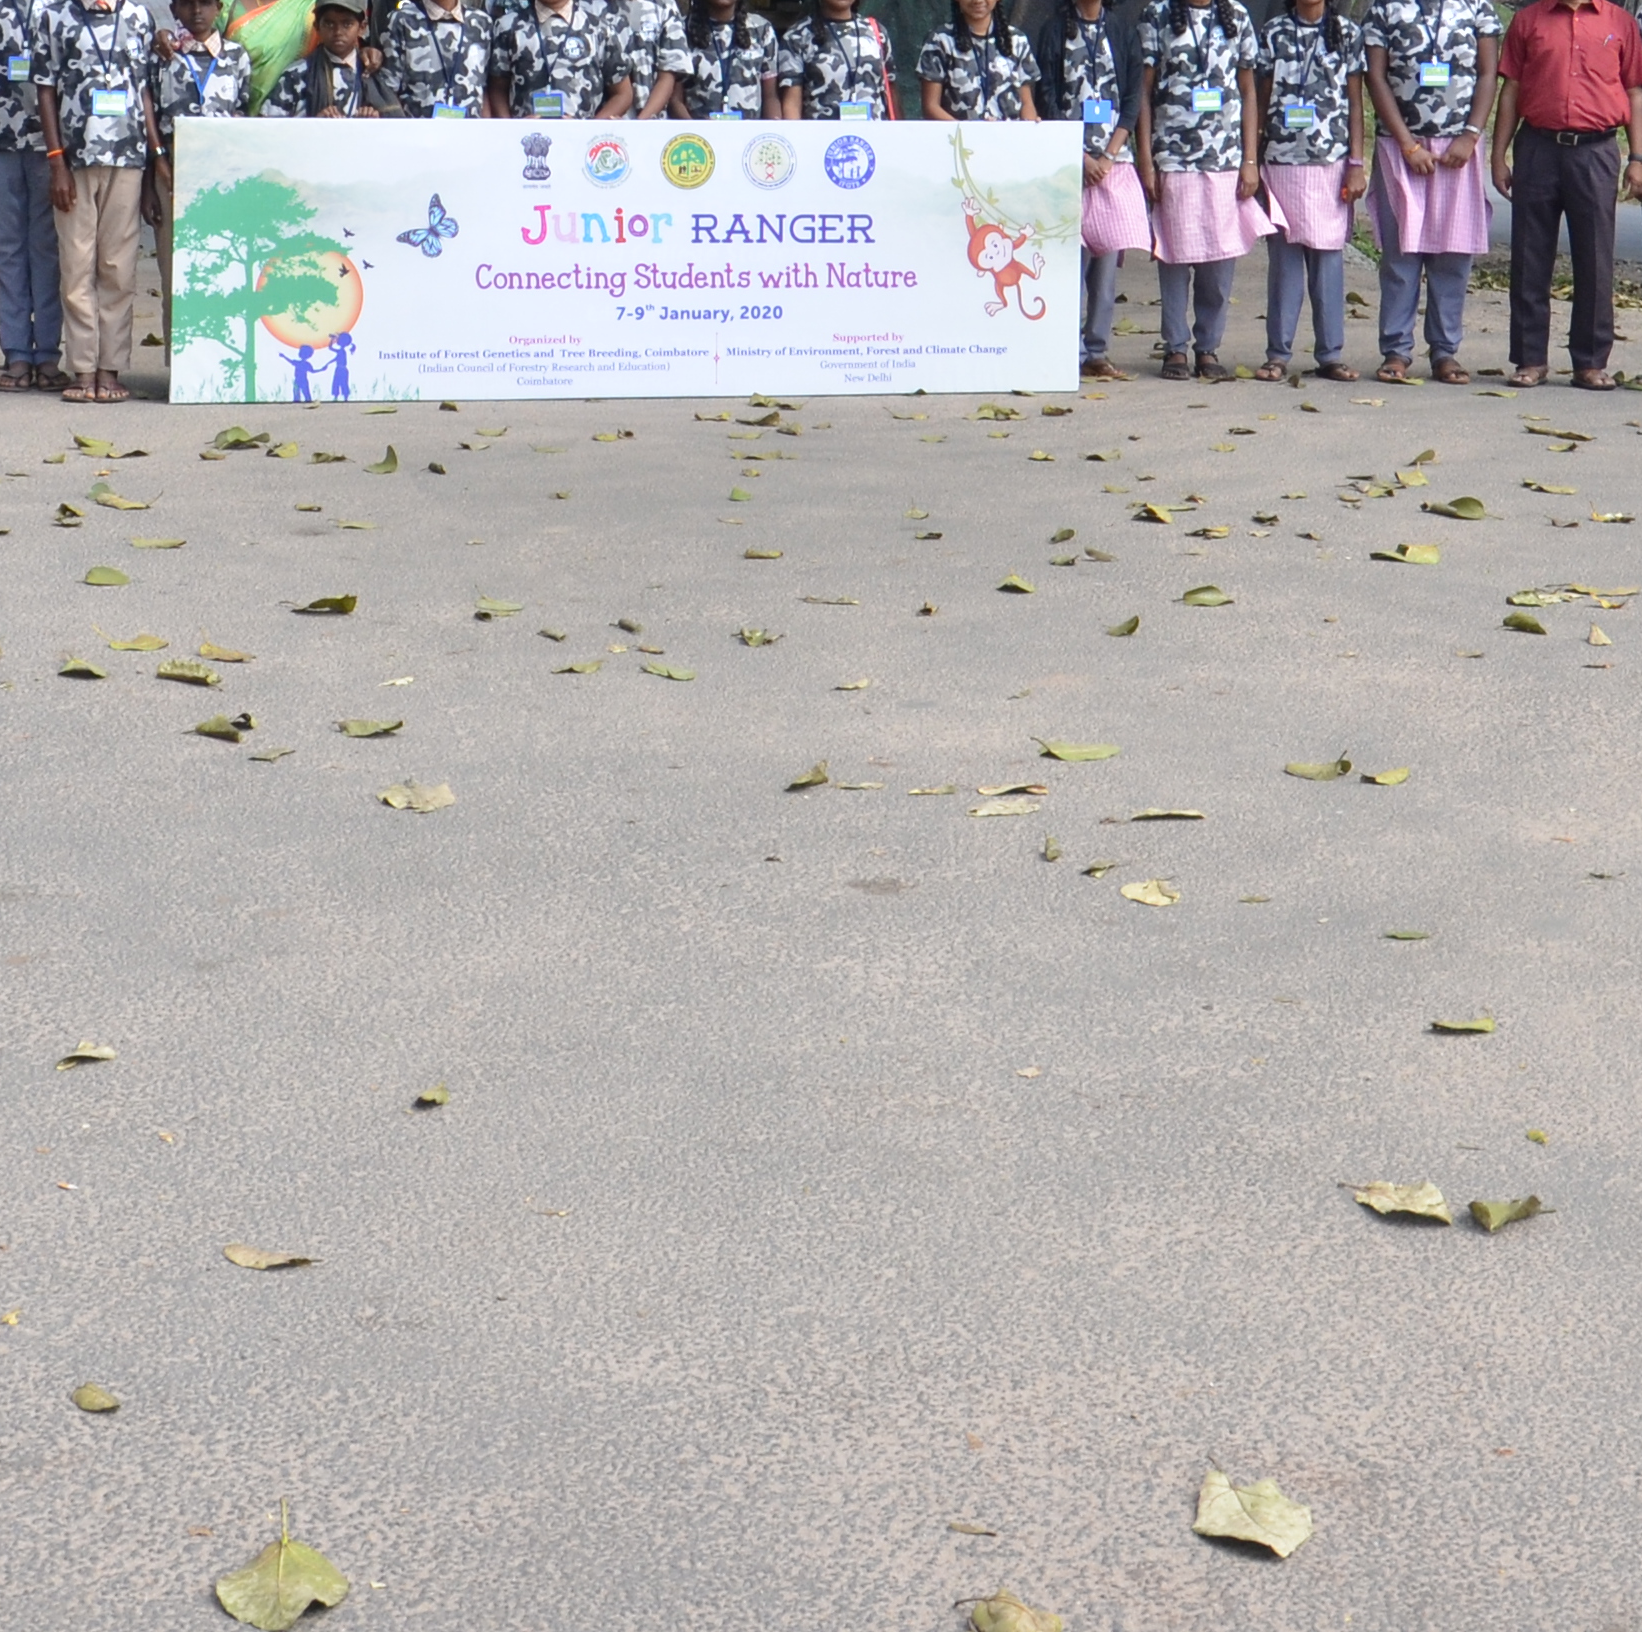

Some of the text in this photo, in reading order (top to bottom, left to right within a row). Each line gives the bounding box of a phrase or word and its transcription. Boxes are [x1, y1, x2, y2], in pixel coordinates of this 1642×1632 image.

[521, 204, 875, 245] Junior RANGER
[475, 262, 918, 297] Connecting Students with Nature
[659, 306, 734, 322] January,
[739, 305, 783, 320] 2020
[509, 334, 582, 346] Organized by
[832, 332, 904, 343] Supported by
[378, 347, 709, 360] Institute of Forest Genetics and Tree Breeding, Coimbatore
[726, 344, 1007, 358] Ministry of Environment, Forest and Climate Change
[418, 363, 454, 374] (Indian
[456, 363, 494, 373] Council
[496, 362, 507, 372] of
[509, 362, 548, 374] Forestry
[551, 362, 595, 372] Research
[597, 361, 615, 371] and
[820, 359, 916, 369] Government of India
[516, 376, 573, 386] Coimbatore
[844, 373, 892, 382] New Delhi
